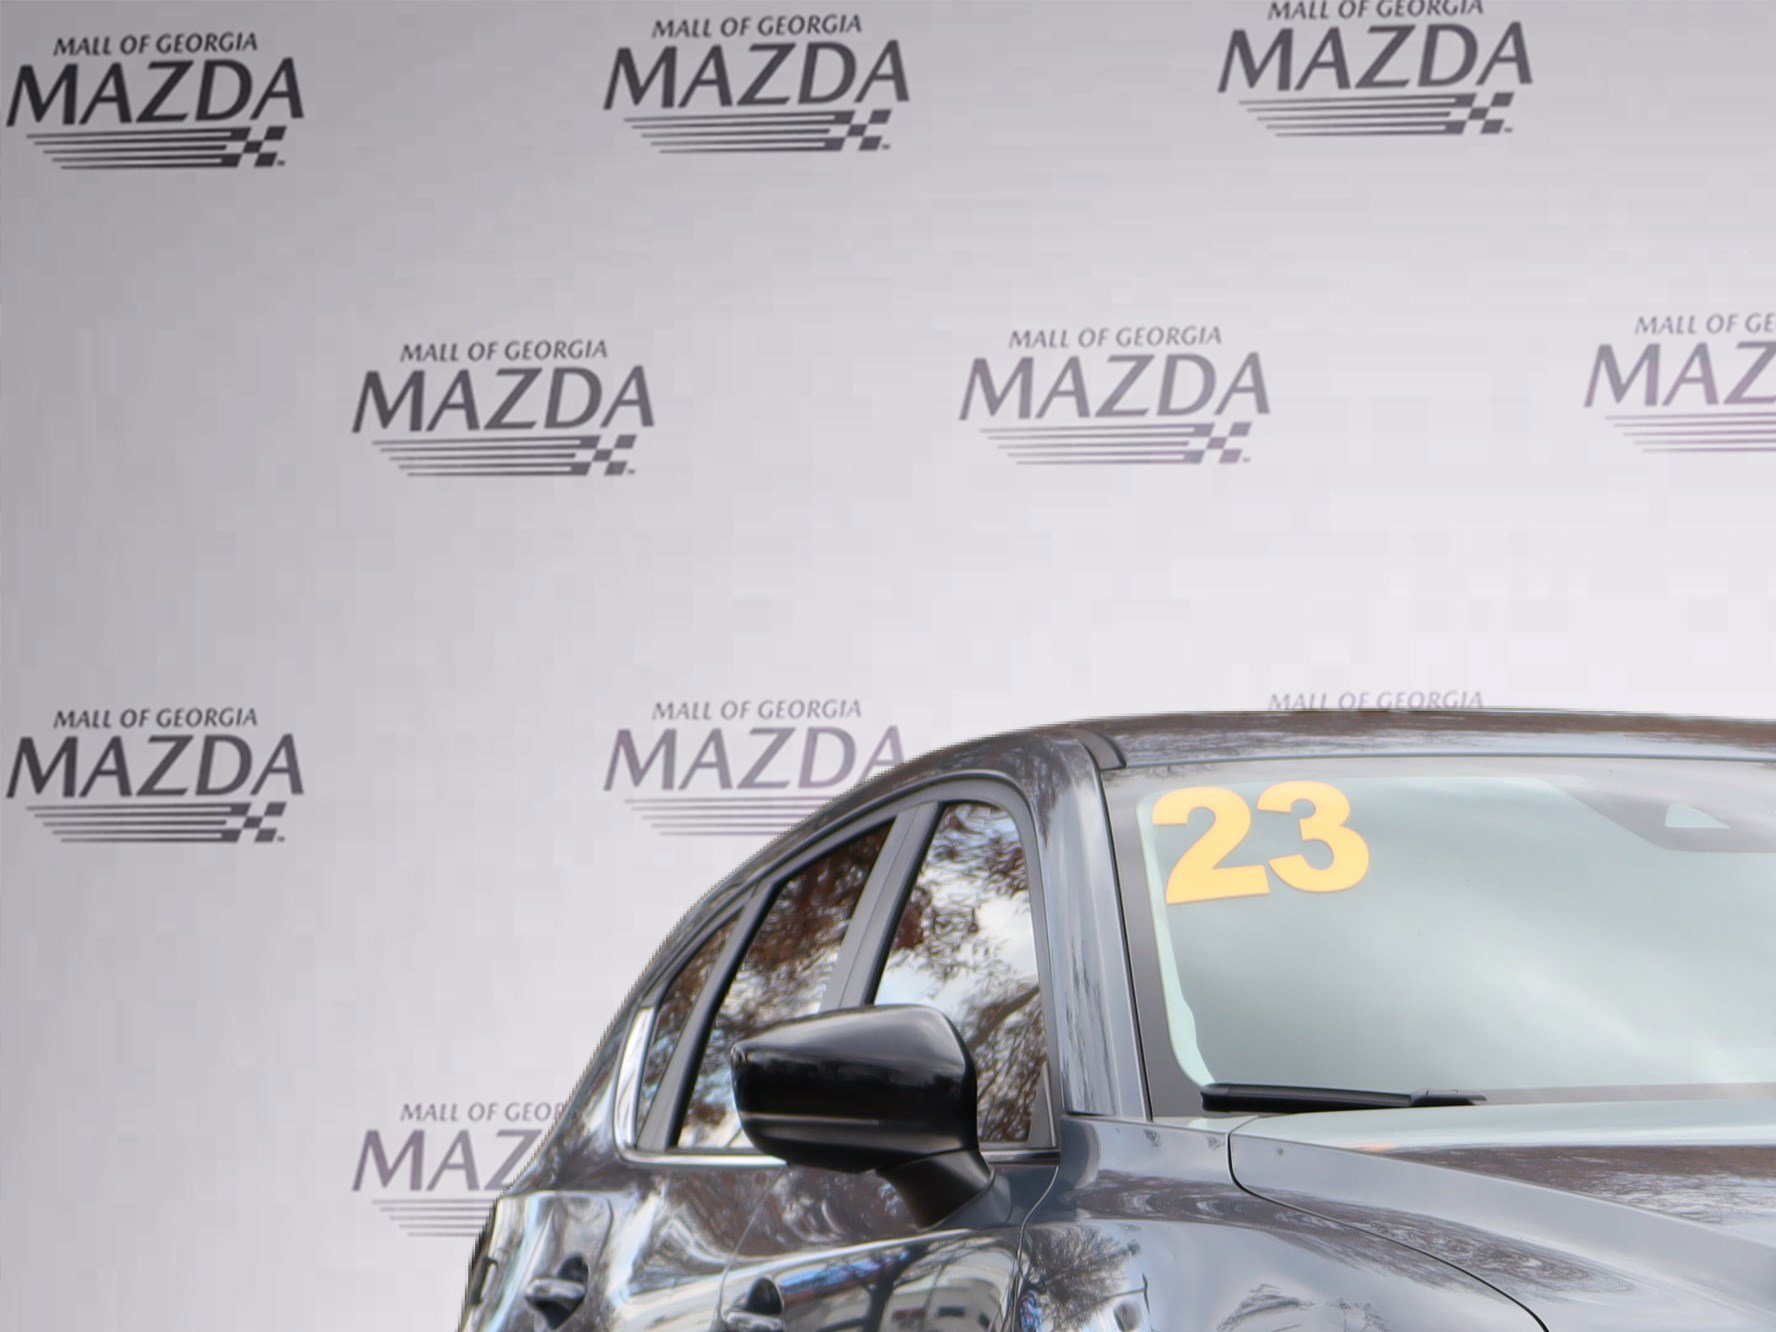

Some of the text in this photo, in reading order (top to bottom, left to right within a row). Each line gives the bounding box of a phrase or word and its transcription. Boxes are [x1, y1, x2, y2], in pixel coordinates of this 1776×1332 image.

[1267, 0, 1484, 20] MALL OF GEORGIA
[651, 13, 862, 39] MALL OF GEORGIA
[53, 31, 258, 57] MALL OF GEORGIA
[1217, 21, 1534, 93] MAZDA
[603, 39, 910, 111] MAZDA
[6, 56, 305, 128] MAZDA
[1008, 325, 1222, 349] MALL OF GEORGIA
[1634, 314, 1697, 335] MALL
[1705, 313, 1738, 335] OF
[399, 339, 608, 363] MALL OF GEORGIA
[351, 365, 655, 433] MAZDA
[958, 351, 1271, 421] MAZDA
[53, 706, 258, 729] MALL OF GEORGIA
[651, 698, 862, 721] MALL OF GEORGIA
[5, 733, 304, 799] MAZDA
[1152, 780, 1370, 905] 23
[400, 1103, 459, 1122] MALL
[467, 1103, 498, 1121] OF
[351, 1129, 543, 1192] MAZ
